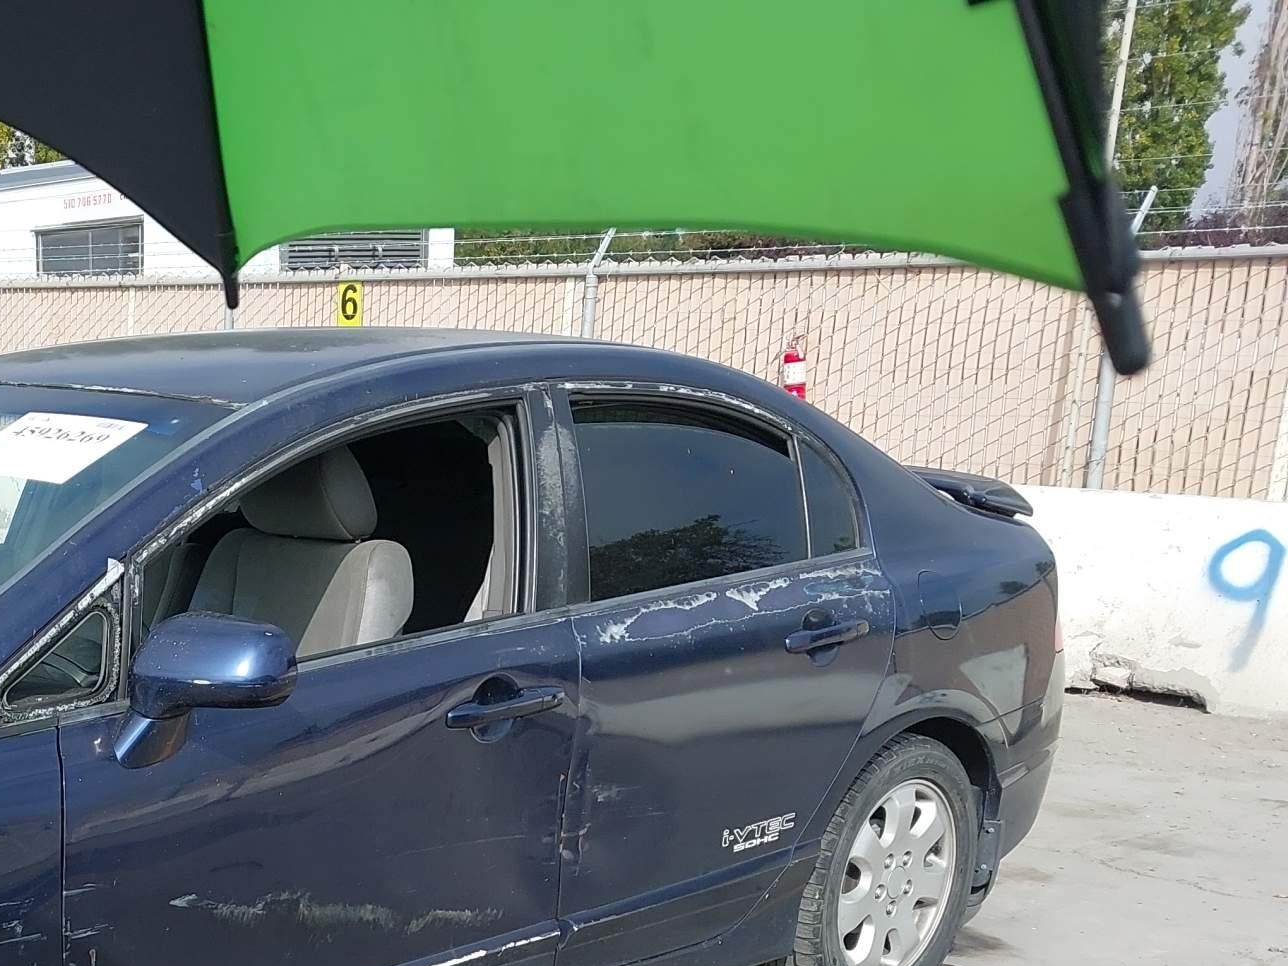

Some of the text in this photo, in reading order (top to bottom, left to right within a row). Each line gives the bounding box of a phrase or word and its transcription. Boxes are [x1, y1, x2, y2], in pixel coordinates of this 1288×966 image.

[341, 283, 358, 321] 6
[1208, 528, 1287, 673] 9
[732, 831, 780, 853] SOHC
